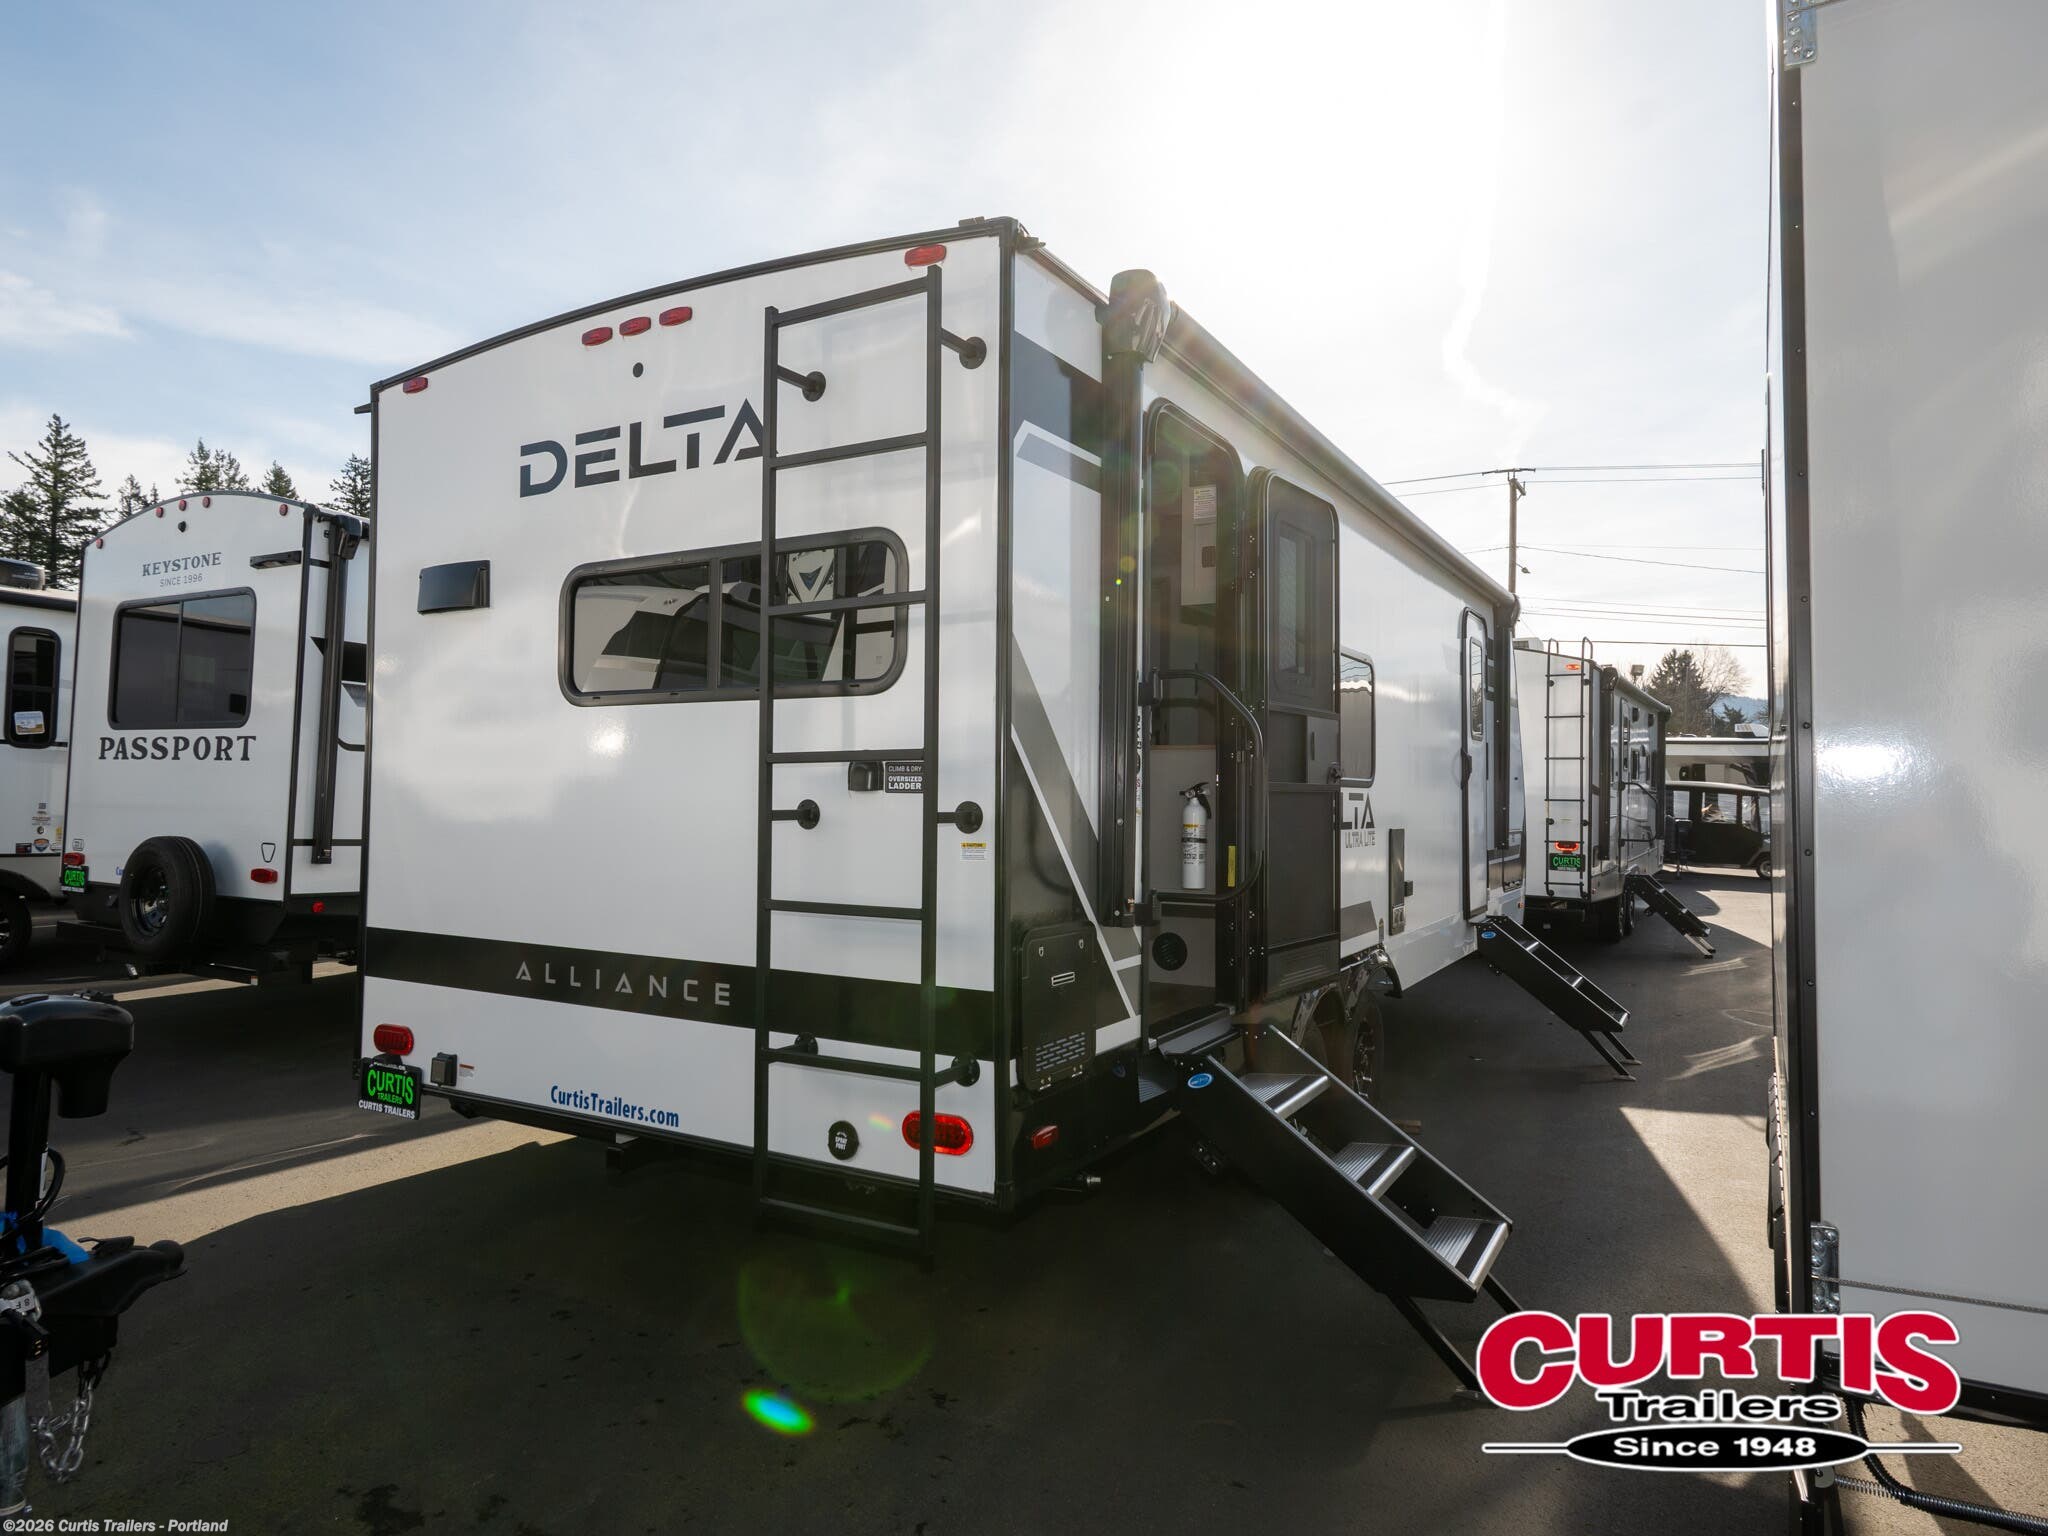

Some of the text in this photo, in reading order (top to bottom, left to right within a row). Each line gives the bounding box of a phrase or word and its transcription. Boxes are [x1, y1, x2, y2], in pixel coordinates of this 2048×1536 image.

[519, 398, 778, 498] DELTA
[142, 552, 222, 577] KEYSTONE
[160, 573, 203, 587] SINCE 1996
[98, 735, 257, 761] PASSPORT
[888, 782, 922, 790] LADDER
[1340, 792, 1375, 830] LTA
[1553, 856, 1581, 868] CURTIS
[515, 960, 730, 1006] ALLIANCE
[367, 1069, 414, 1105] CURTIS
[377, 1092, 403, 1105] TRAILERS
[359, 1099, 416, 1120] CURTIS TRAILERS
[551, 1085, 680, 1128] CurtisTrailers.com
